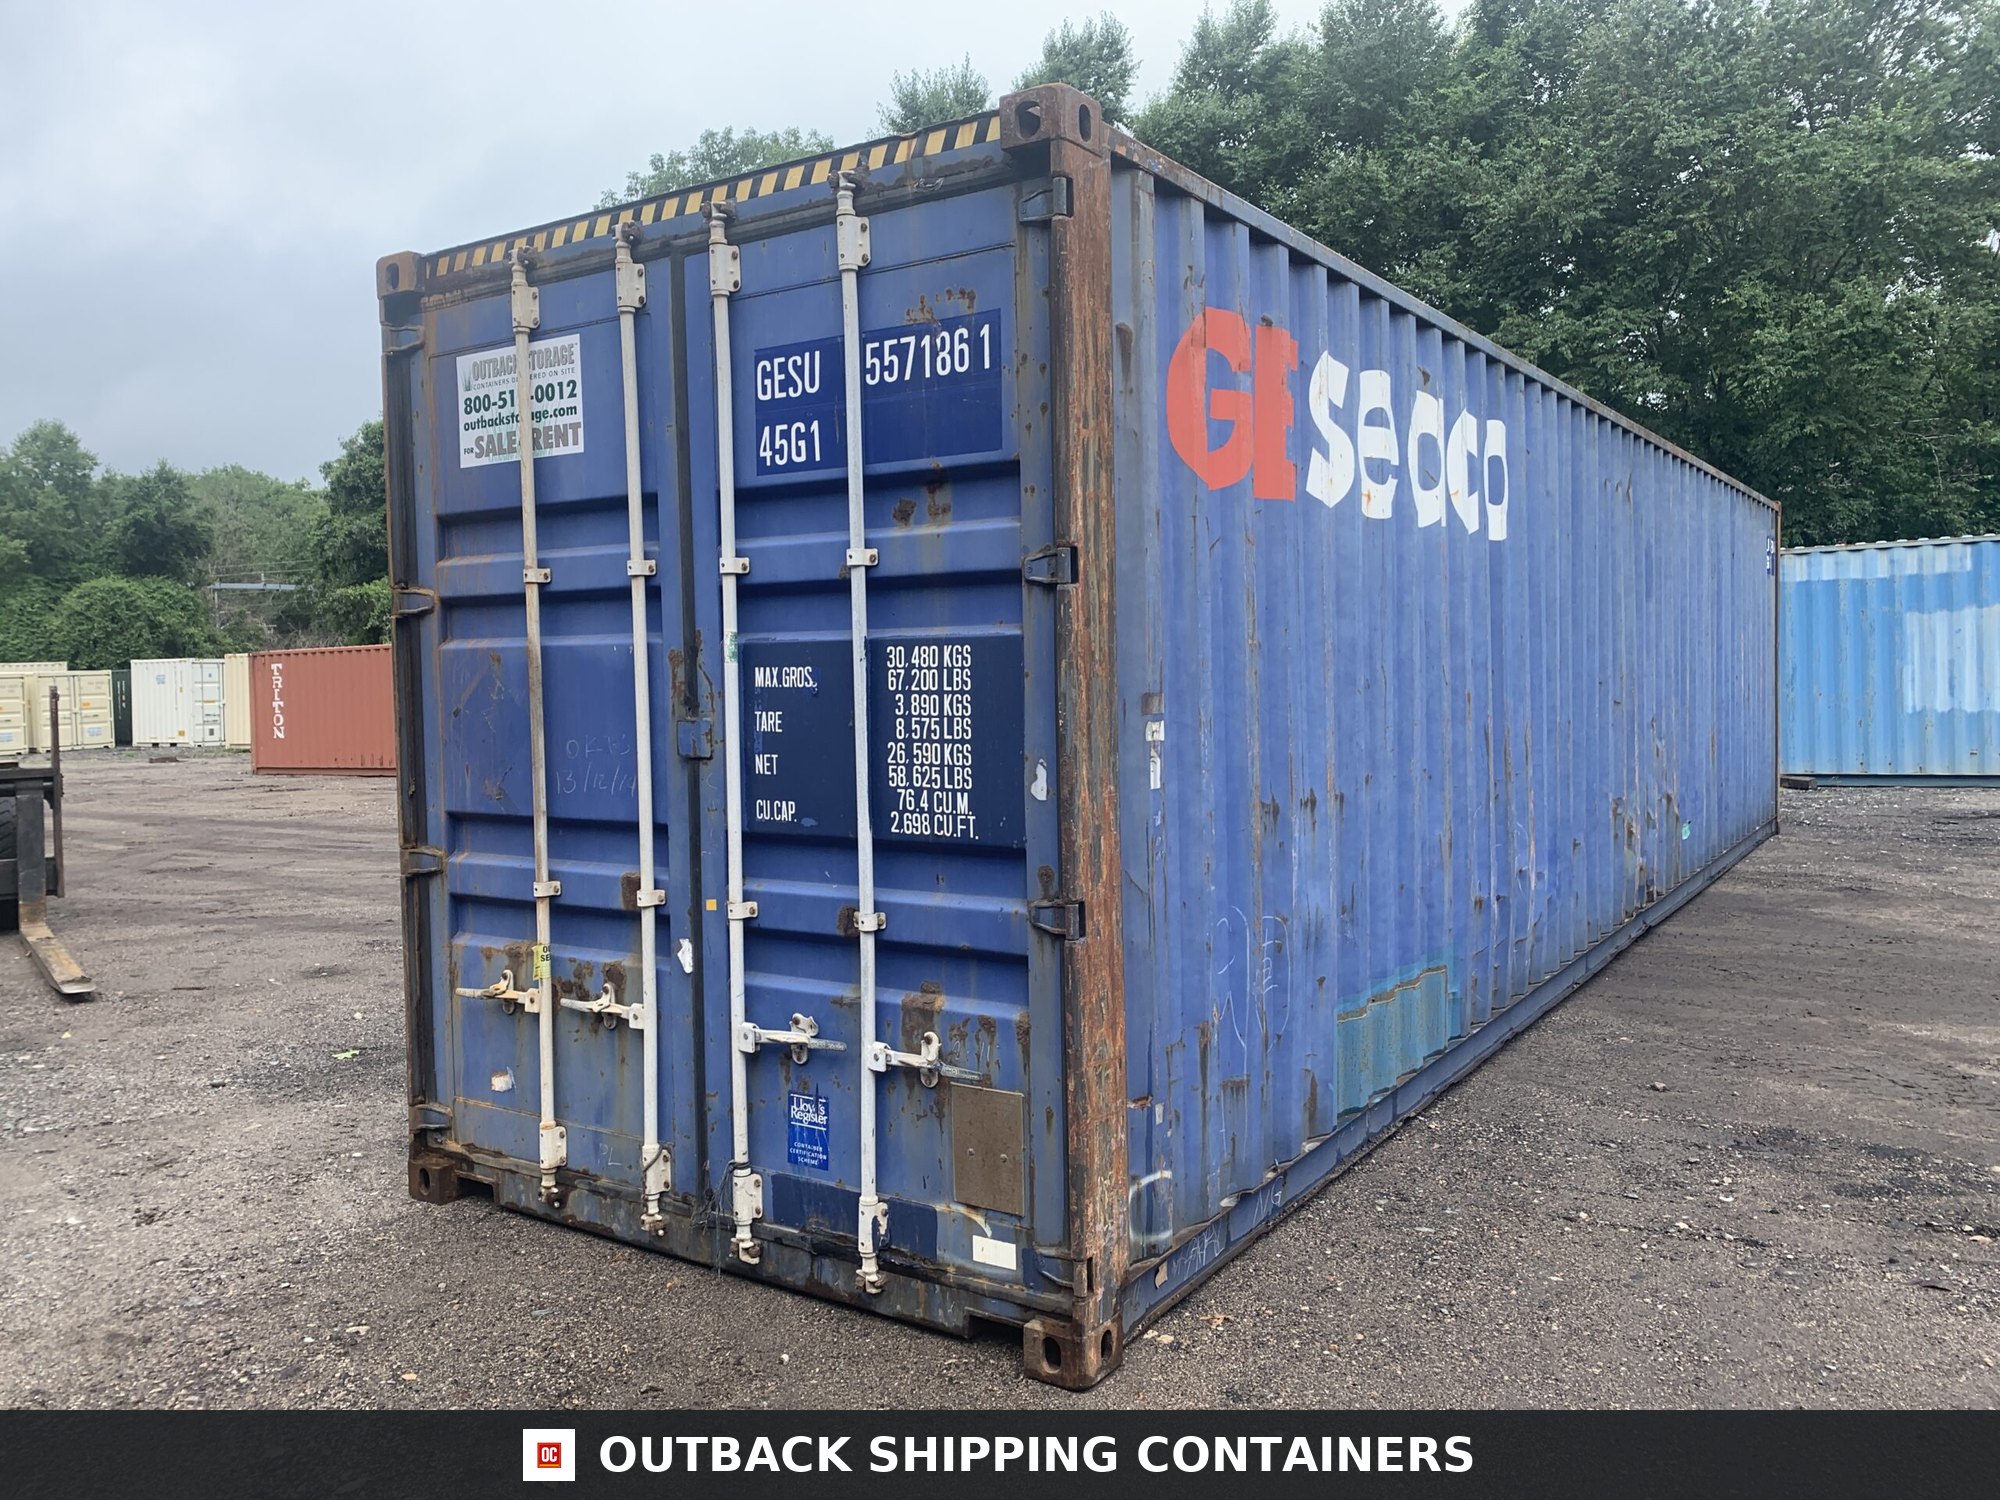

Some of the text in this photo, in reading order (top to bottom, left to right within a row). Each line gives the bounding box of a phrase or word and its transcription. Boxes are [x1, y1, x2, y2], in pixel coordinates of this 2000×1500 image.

[472, 343, 575, 381] OUTBAC TORAGE
[473, 378, 510, 391] CONTAINERS
[548, 370, 559, 378] ON
[560, 366, 576, 376] SITE
[756, 350, 820, 401] GESU
[463, 379, 578, 415] 800-51-0012
[463, 421, 582, 459] FOR SALE RENT
[759, 419, 821, 466] 45G1
[943, 645, 971, 667] KGS
[943, 669, 971, 691] LBS
[270, 663, 285, 739] TRITON
[943, 694, 971, 716] KGS
[754, 711, 783, 733] TARE
[943, 717, 972, 739] LBS
[755, 754, 778, 775] NET
[944, 743, 972, 766] KGS
[944, 767, 973, 790] LBS
[756, 799, 798, 823] CU.CAP.
[896, 789, 928, 813] 76.4
[790, 1105, 828, 1125] Register
[789, 1147, 827, 1160] CERTIFICATION
[793, 1141, 823, 1153] CONTAINER
[797, 1156, 818, 1166] SCHEME
